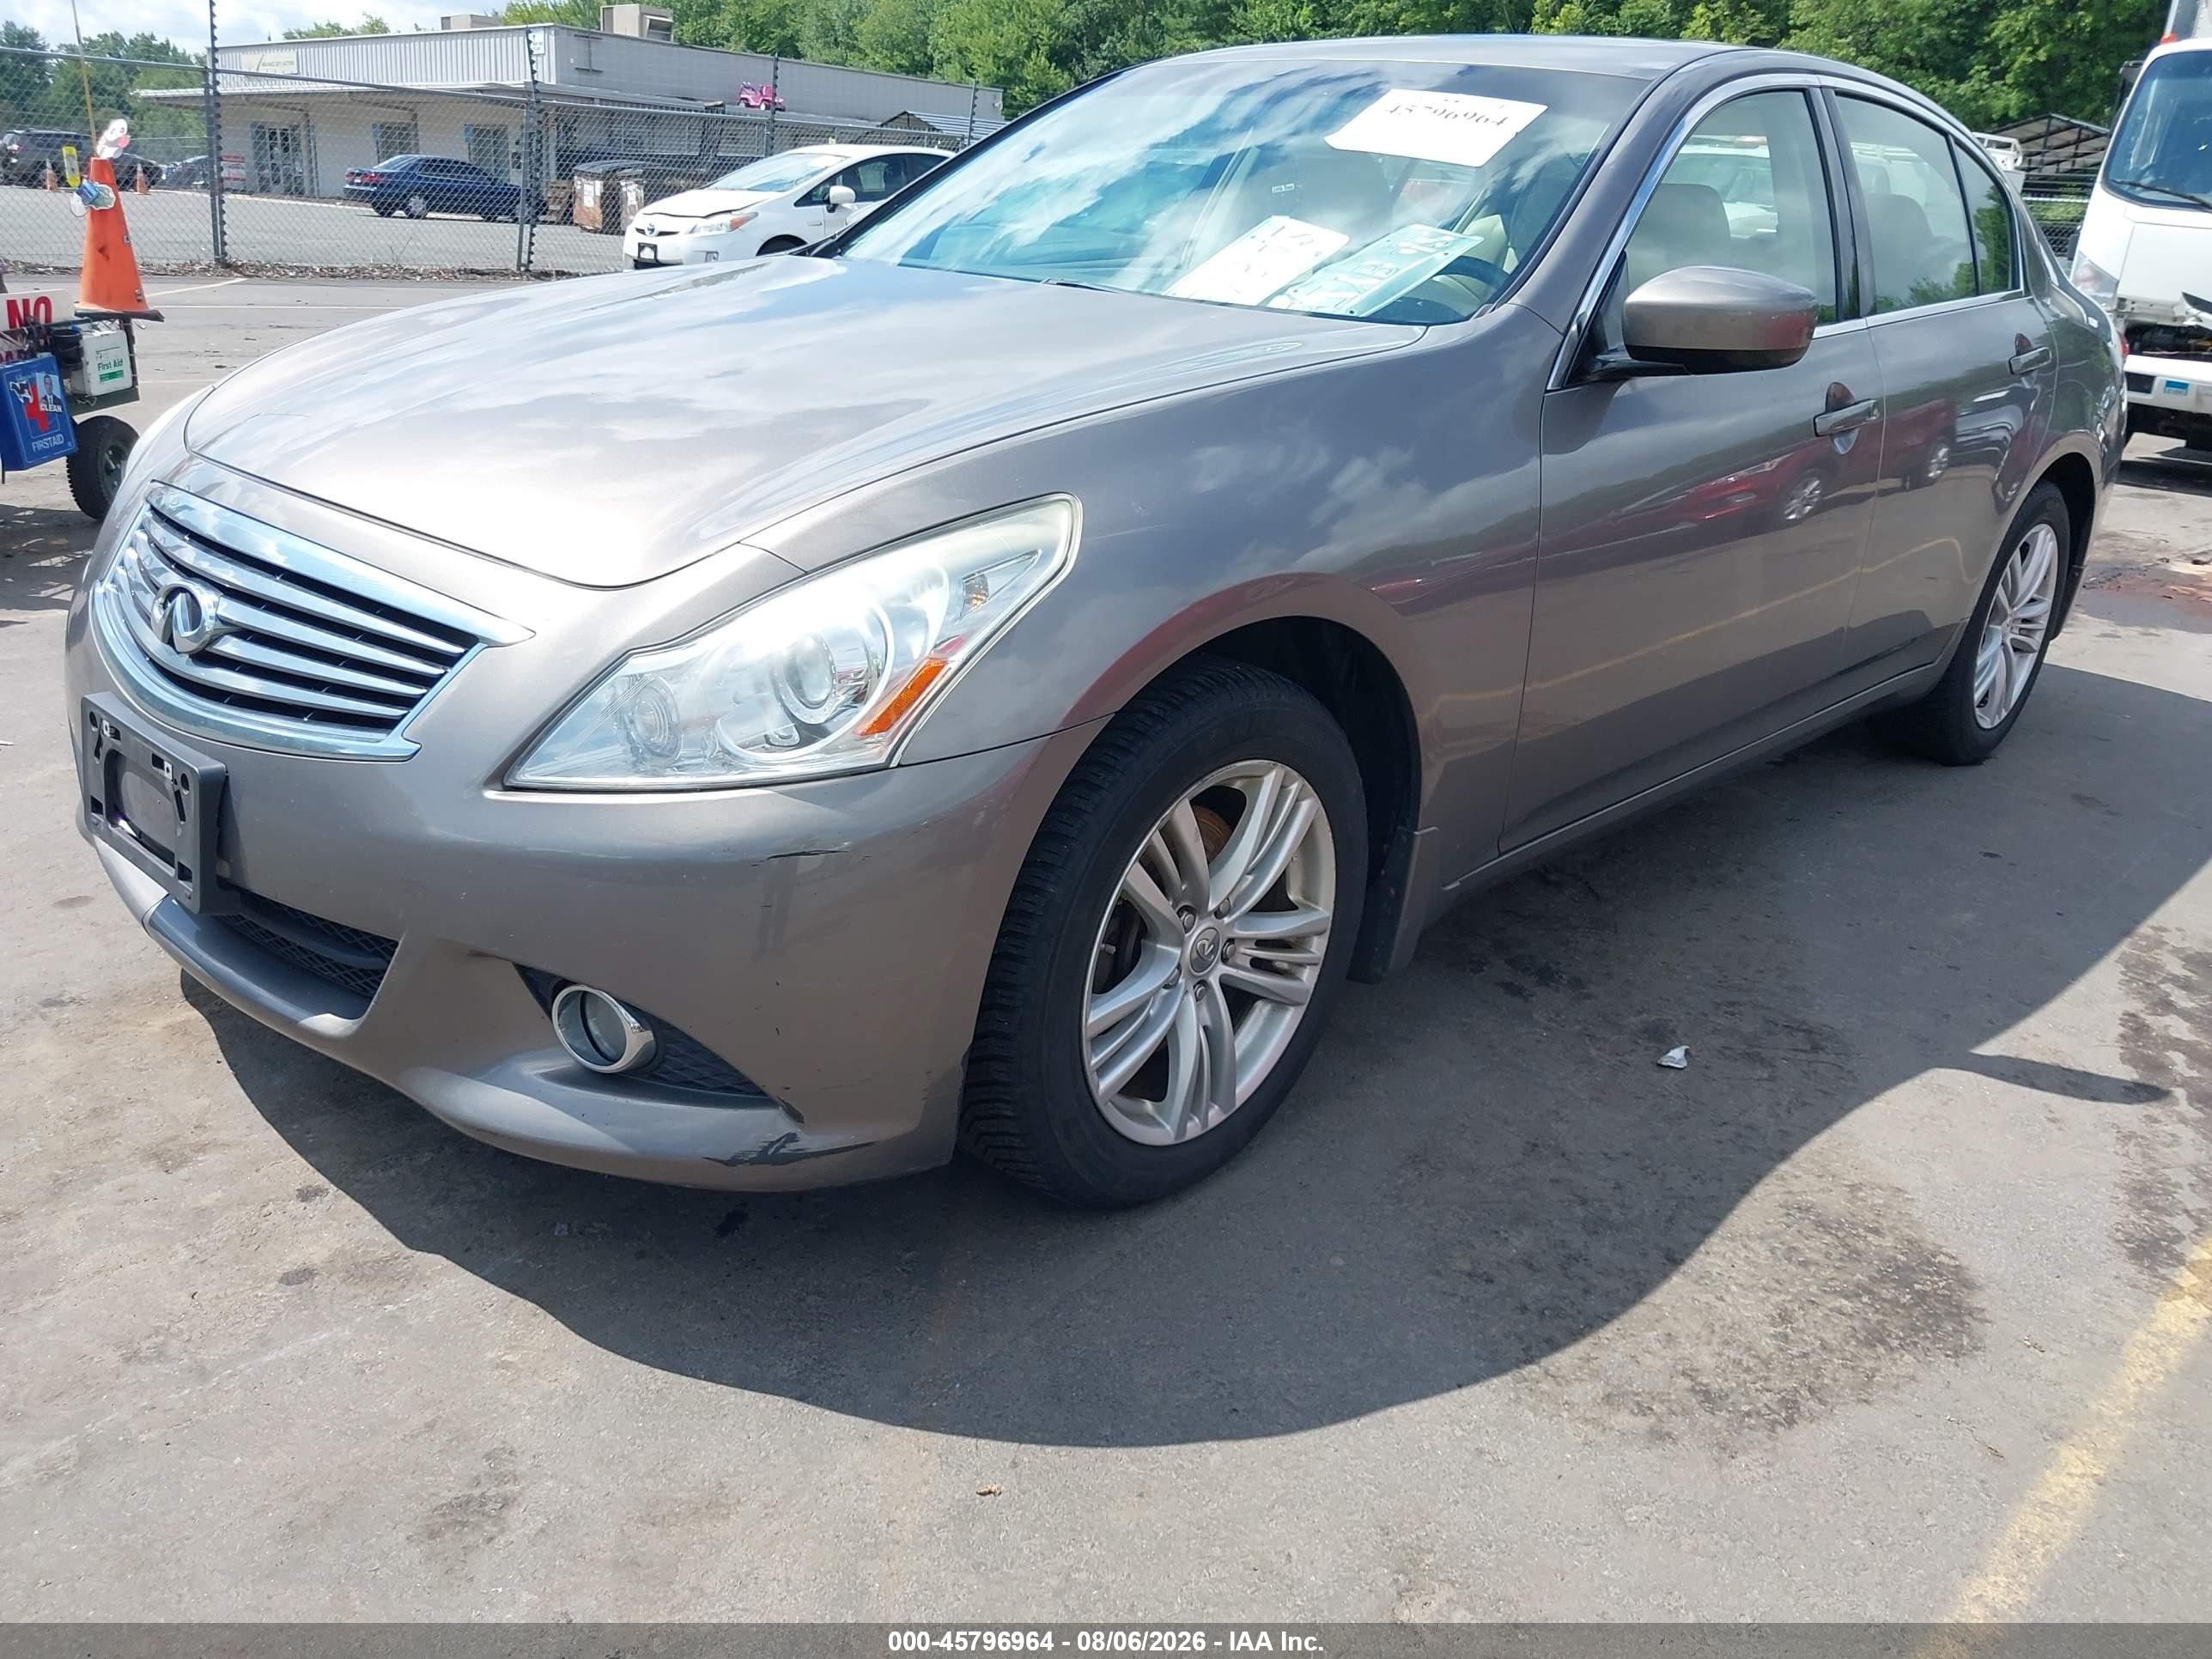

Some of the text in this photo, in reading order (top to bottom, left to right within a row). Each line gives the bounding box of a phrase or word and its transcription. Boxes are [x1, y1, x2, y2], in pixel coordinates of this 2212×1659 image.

[6, 295, 53, 330] NO
[97, 357, 123, 372] First Aid
[40, 404, 63, 413] CLEAN
